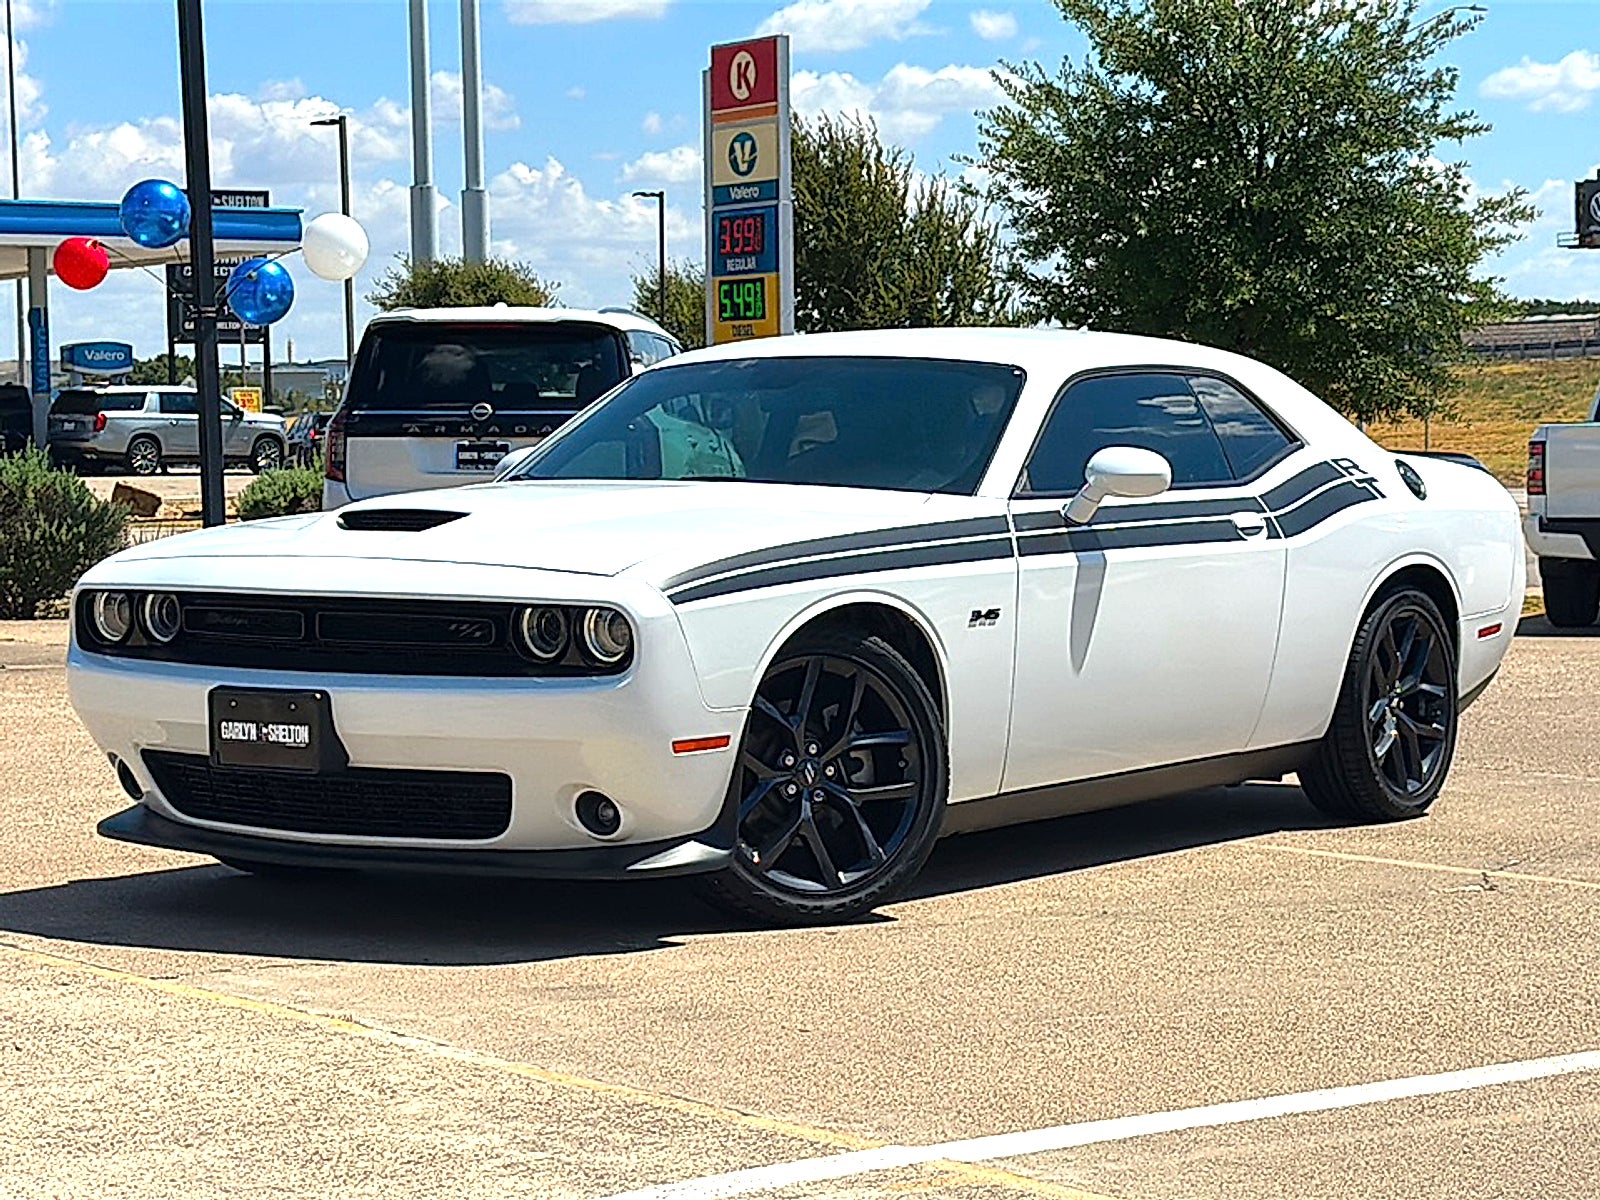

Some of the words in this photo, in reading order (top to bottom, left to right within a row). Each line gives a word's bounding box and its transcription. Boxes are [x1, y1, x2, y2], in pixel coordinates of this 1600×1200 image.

[730, 186, 759, 200] Valero
[221, 194, 265, 208] SHELTON
[84, 349, 125, 361] Valero
[407, 424, 552, 433] ARMADA
[220, 721, 258, 741] GARLYN
[267, 723, 310, 744] SHELTON
